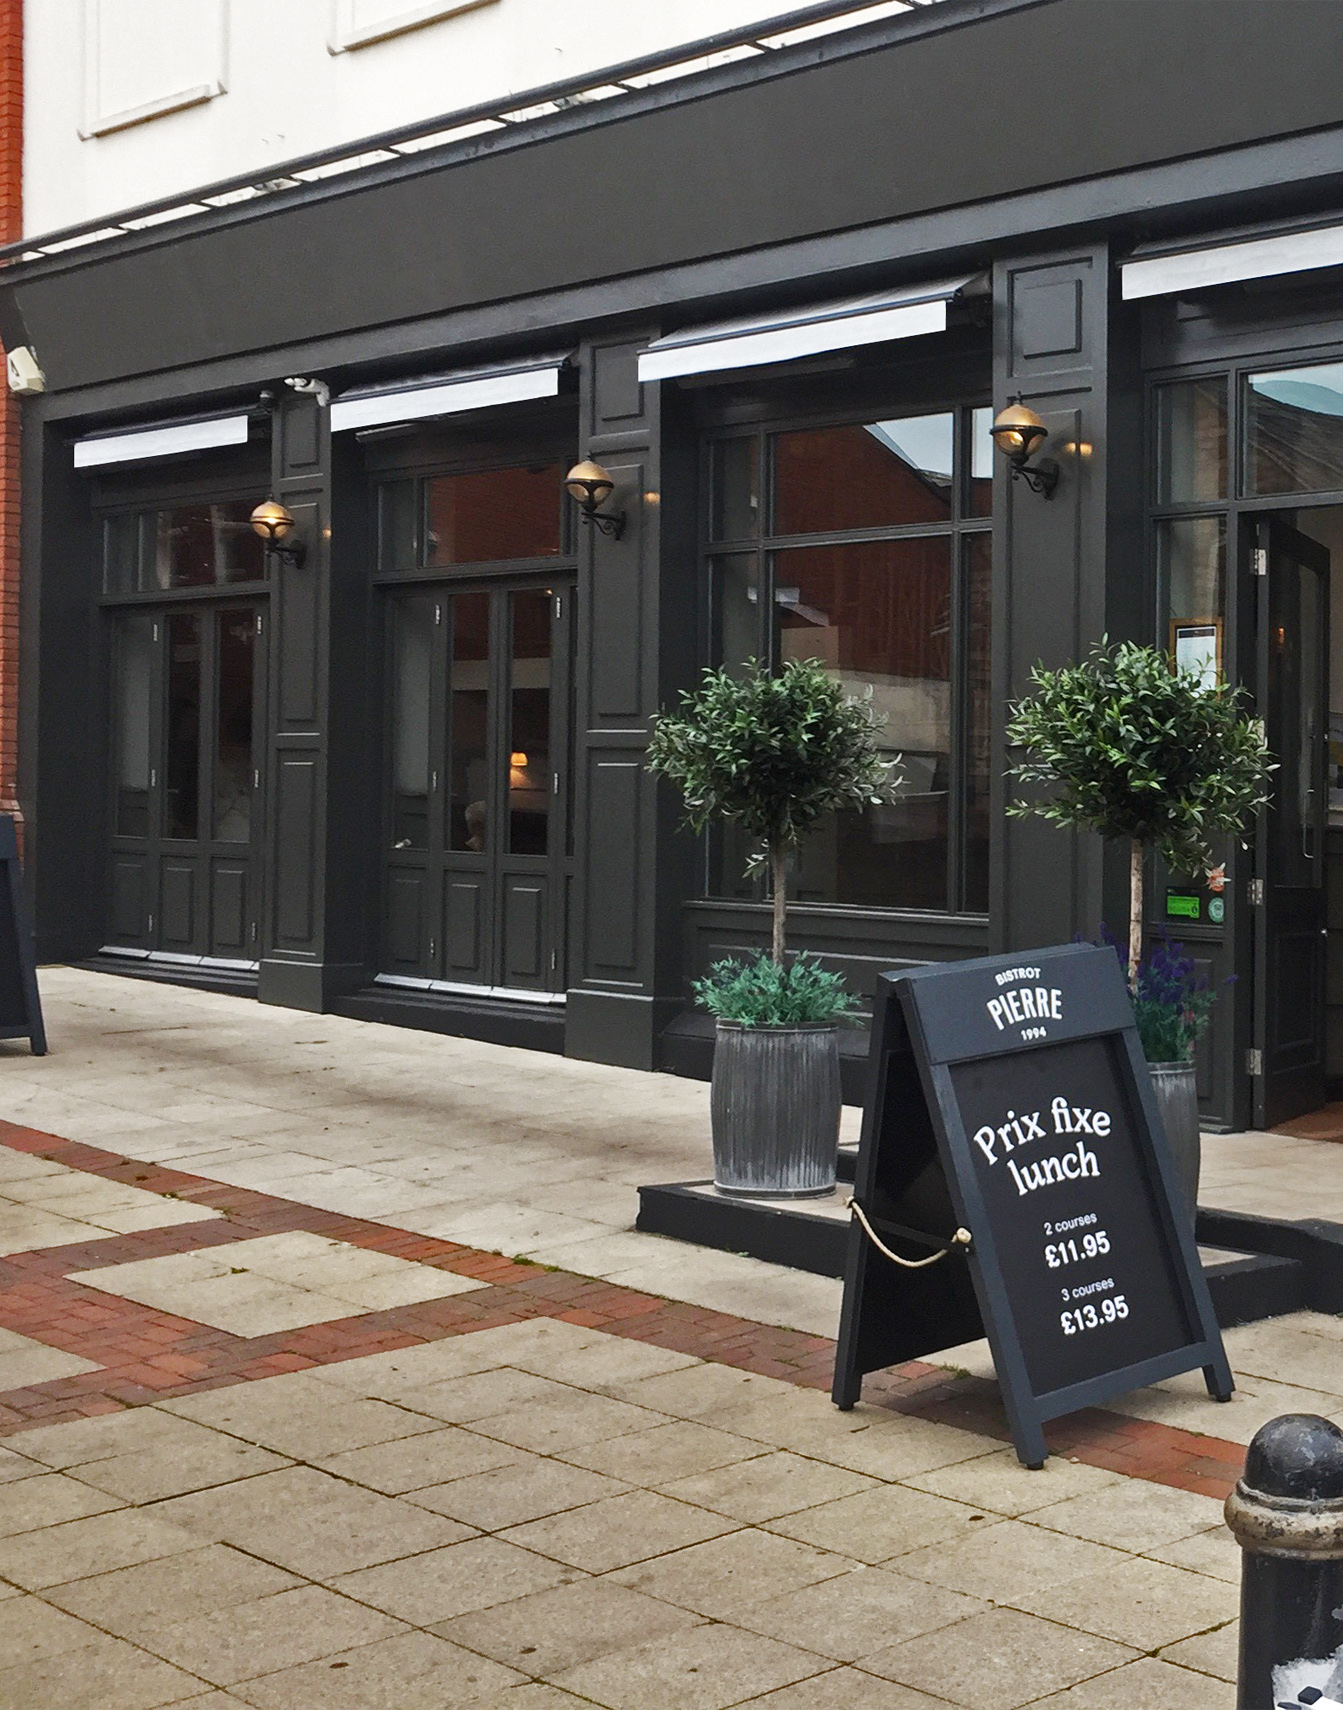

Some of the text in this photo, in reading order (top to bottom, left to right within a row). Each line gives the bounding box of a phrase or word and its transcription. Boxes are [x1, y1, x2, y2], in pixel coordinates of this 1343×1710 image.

[995, 967, 1042, 987] BISTROT
[986, 986, 1063, 1030] PIERRE
[1020, 1026, 1047, 1041] 1994
[974, 1096, 1112, 1166] Prix fixe
[1006, 1139, 1101, 1196] lunch
[1043, 1211, 1098, 1236] 2 courses
[1045, 1230, 1111, 1269] £11.95
[1060, 1276, 1115, 1302] 3 courses
[1060, 1294, 1130, 1335] £13.95
